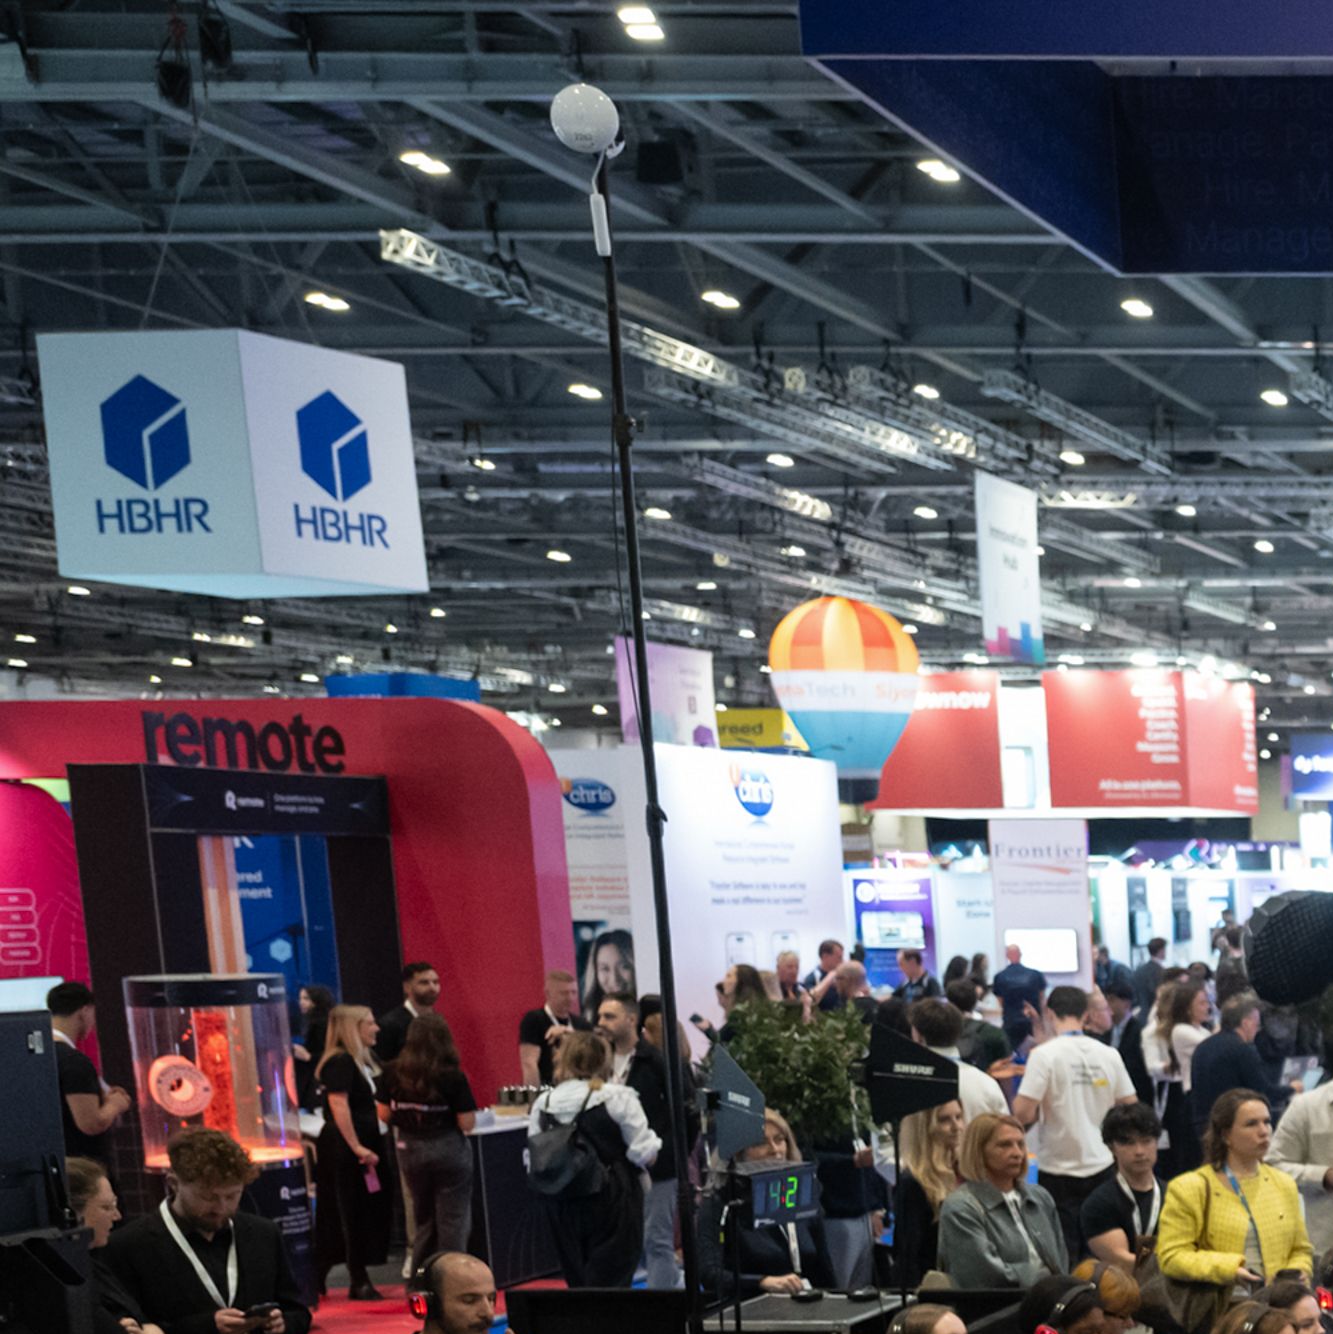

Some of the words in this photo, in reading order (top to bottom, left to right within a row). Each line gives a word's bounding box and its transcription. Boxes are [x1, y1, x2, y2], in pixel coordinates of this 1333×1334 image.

[95, 497, 212, 535] HBHR
[292, 502, 390, 549] HBHR
[141, 711, 346, 774] remote
[994, 842, 1085, 859] Frontier
